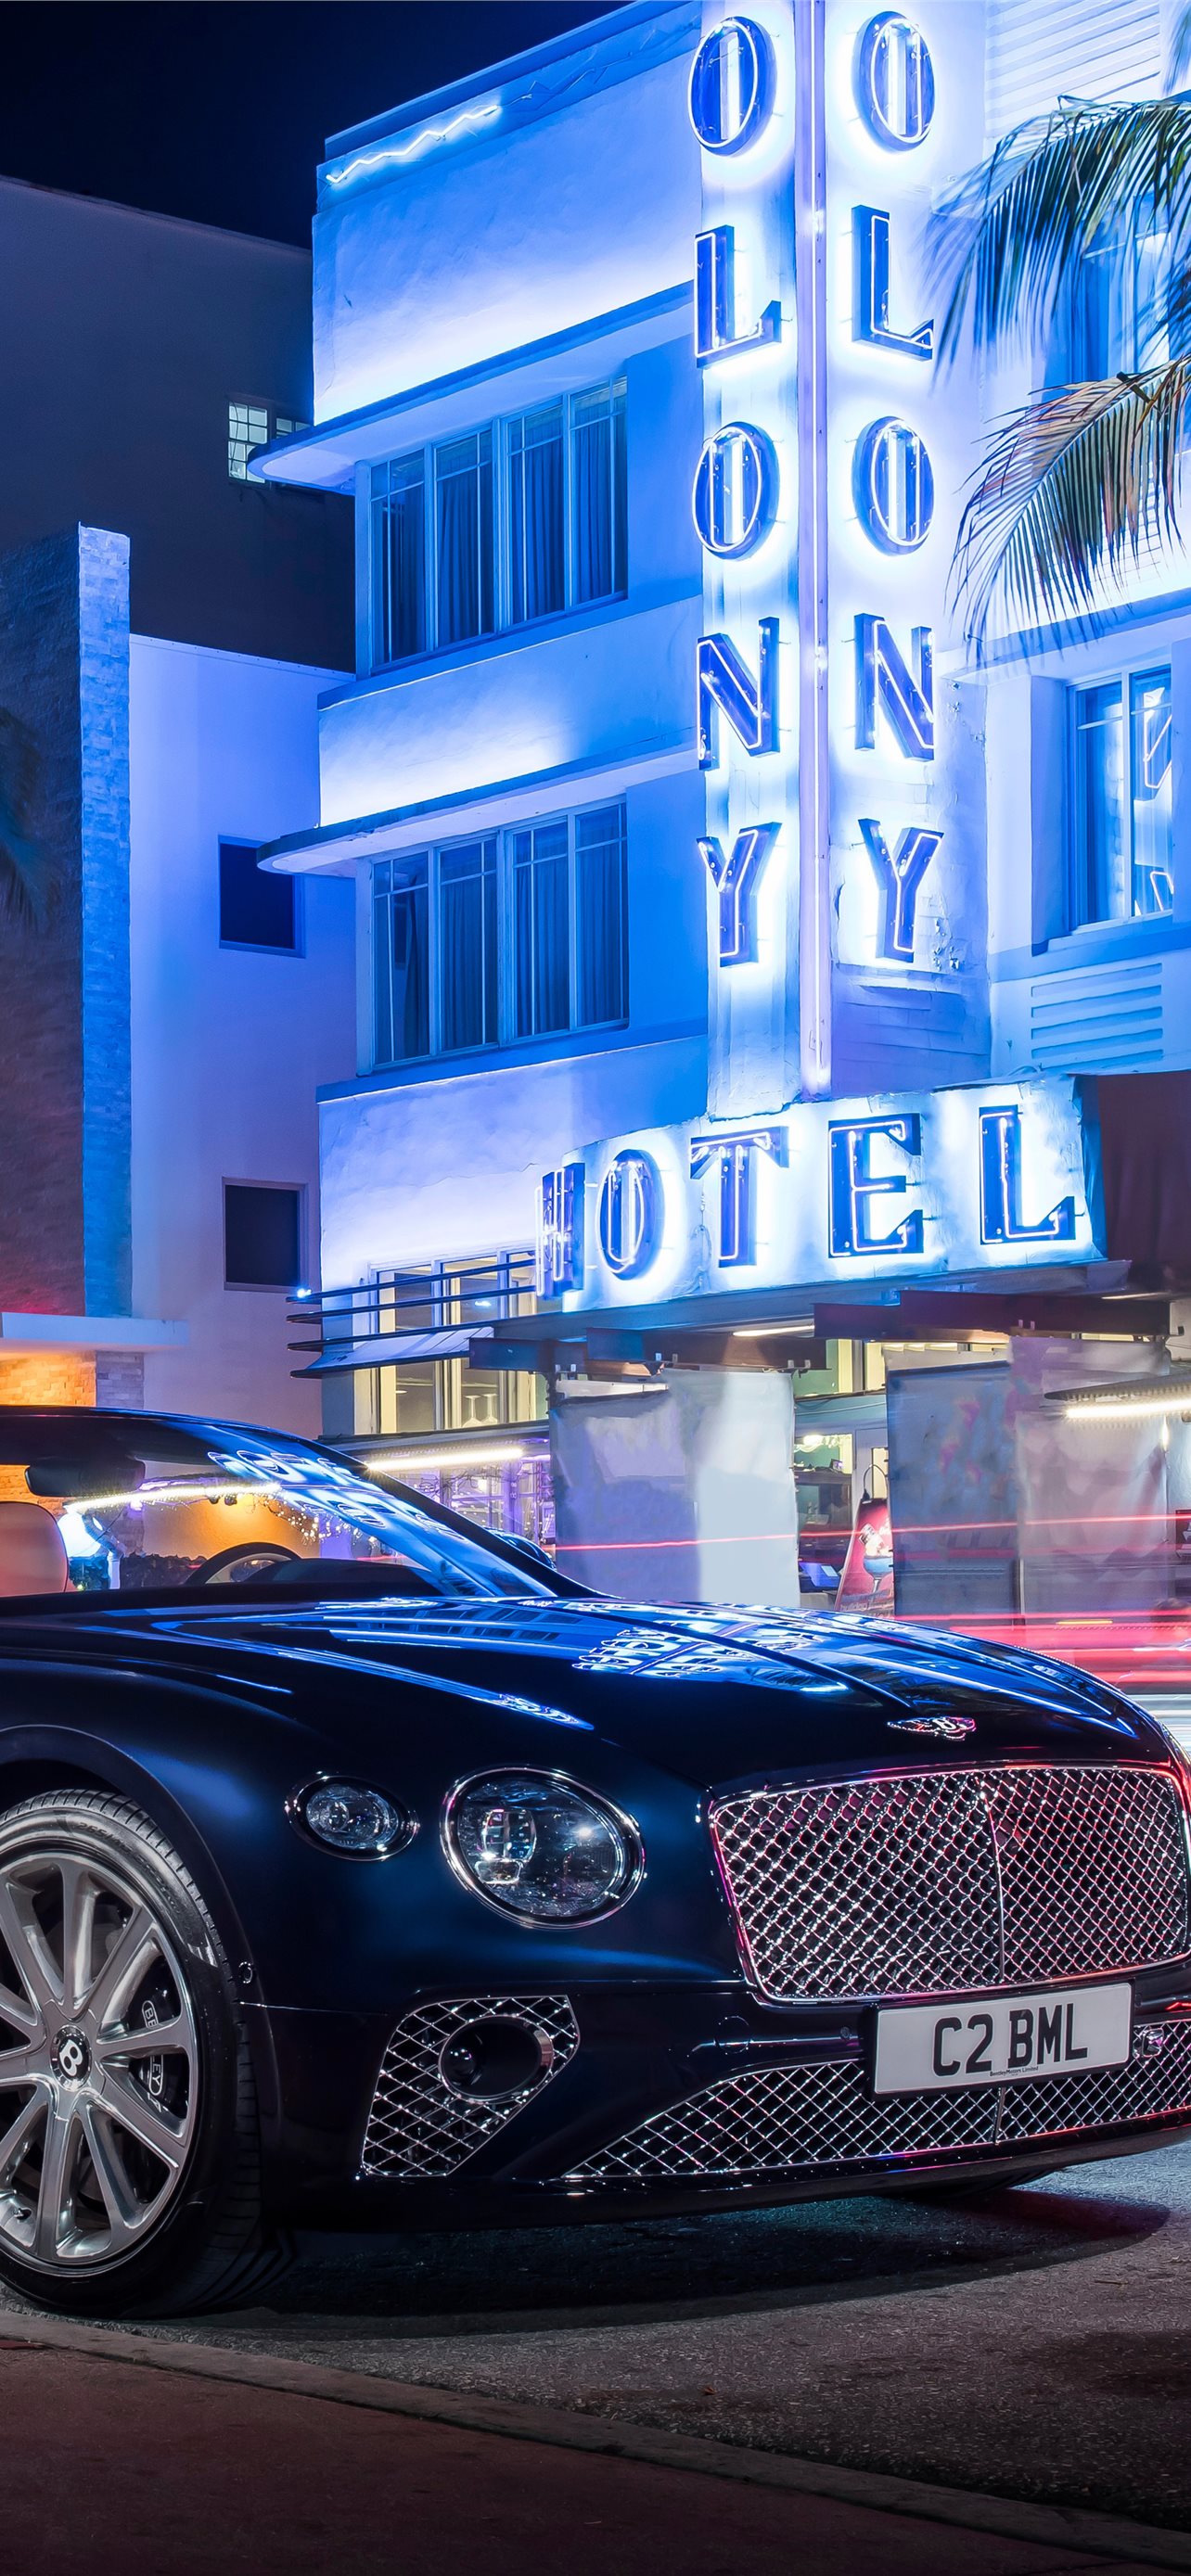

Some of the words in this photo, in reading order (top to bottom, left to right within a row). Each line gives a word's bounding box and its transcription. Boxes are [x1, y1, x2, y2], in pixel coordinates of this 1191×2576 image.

[535, 1104, 1076, 1298] HOTEL
[932, 2013, 993, 2077] C2
[1007, 2003, 1088, 2069] BML
